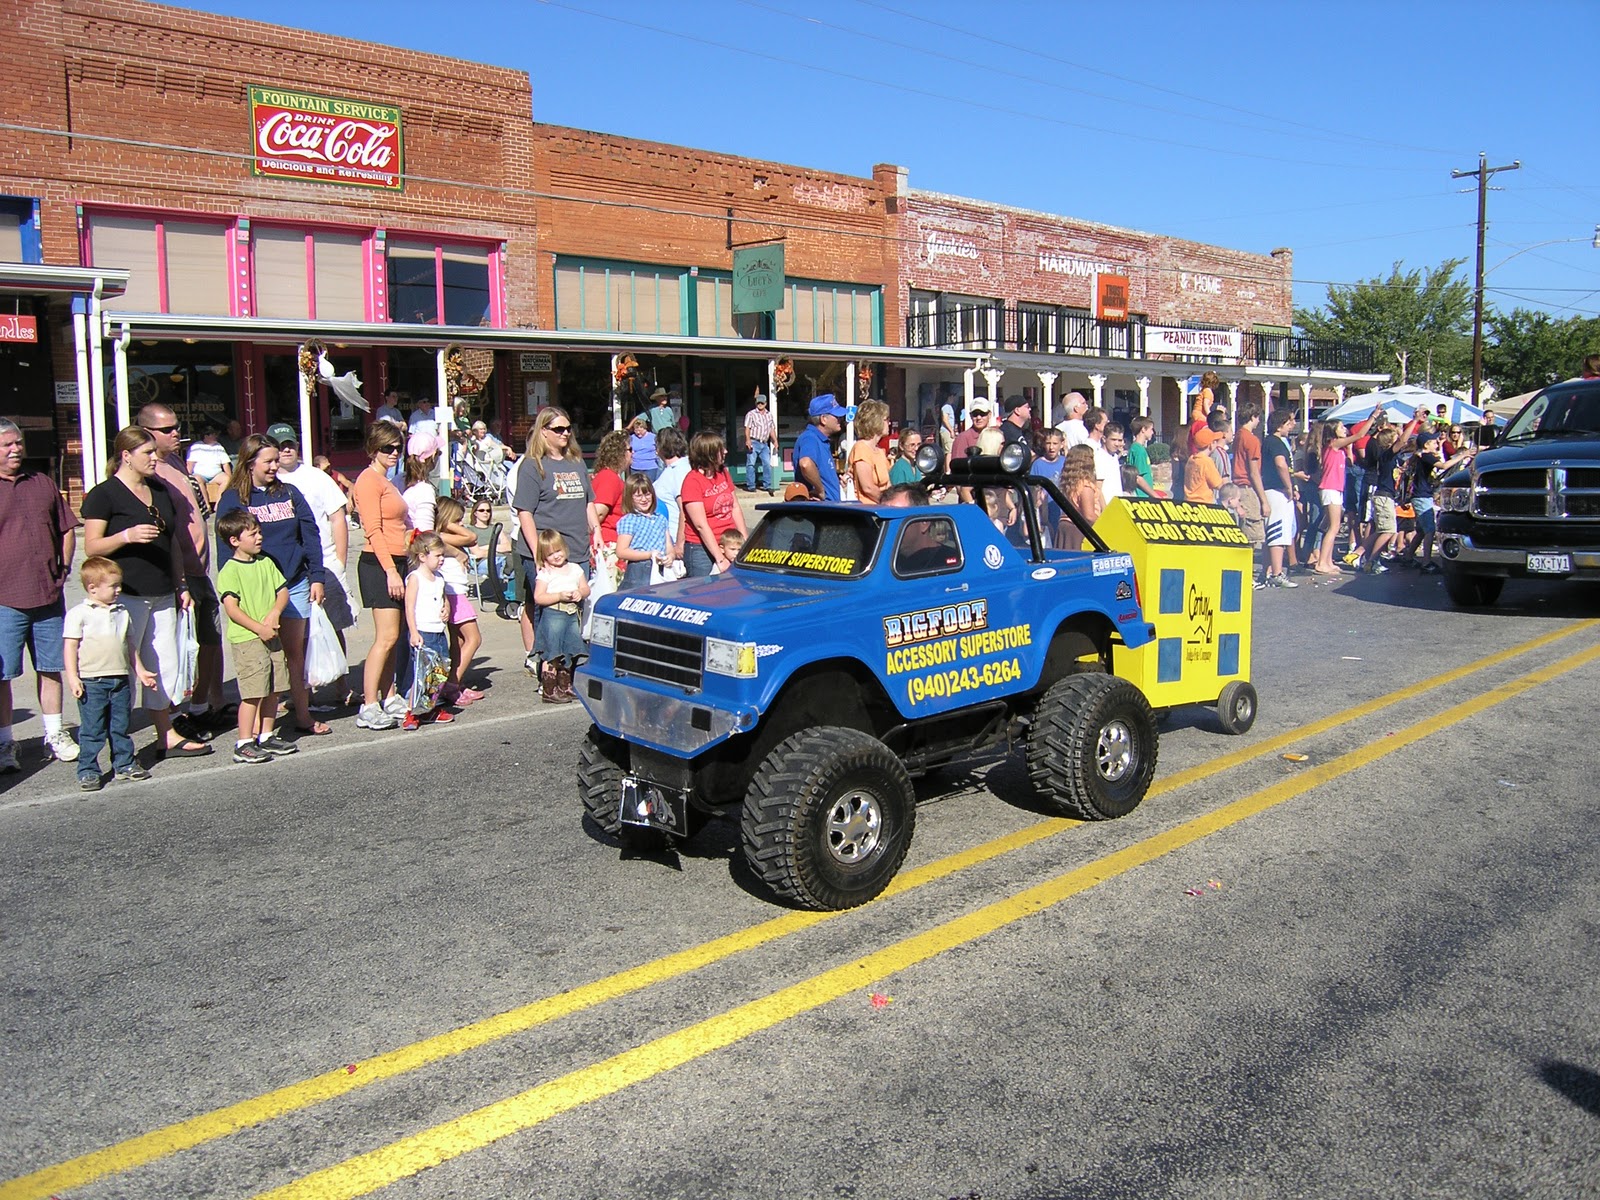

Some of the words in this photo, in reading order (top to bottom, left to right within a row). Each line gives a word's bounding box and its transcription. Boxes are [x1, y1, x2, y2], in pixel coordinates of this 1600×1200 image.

[262, 91, 330, 113] FOUNTAIN
[334, 102, 389, 121] SERVICE
[294, 113, 336, 126] DRINK
[259, 111, 397, 168] Coca-Cola
[262, 159, 314, 173] Delicious
[316, 164, 335, 176] and
[927, 232, 980, 264] Jackie's
[1194, 274, 1222, 294] HOME
[0, 317, 35, 340] ndles
[1163, 331, 1196, 345] PEANUT
[1199, 332, 1233, 346] FESTIVAL
[1122, 499, 1168, 523] Patty
[1161, 501, 1236, 526] McCallum
[1181, 524, 1249, 544] 391-4765
[744, 549, 792, 565] ACCESSORY
[788, 552, 856, 575] SUPERSTORE
[1093, 556, 1132, 571] FABTECH
[618, 597, 663, 617] RUBICON
[659, 605, 713, 626] EXTREME
[1188, 583, 1211, 622] Century
[884, 599, 987, 647] BIGFOOT
[886, 638, 957, 675] ACCESSORY
[960, 624, 1032, 659] SUPERSTORE
[907, 658, 1022, 706] (940)243-6264
